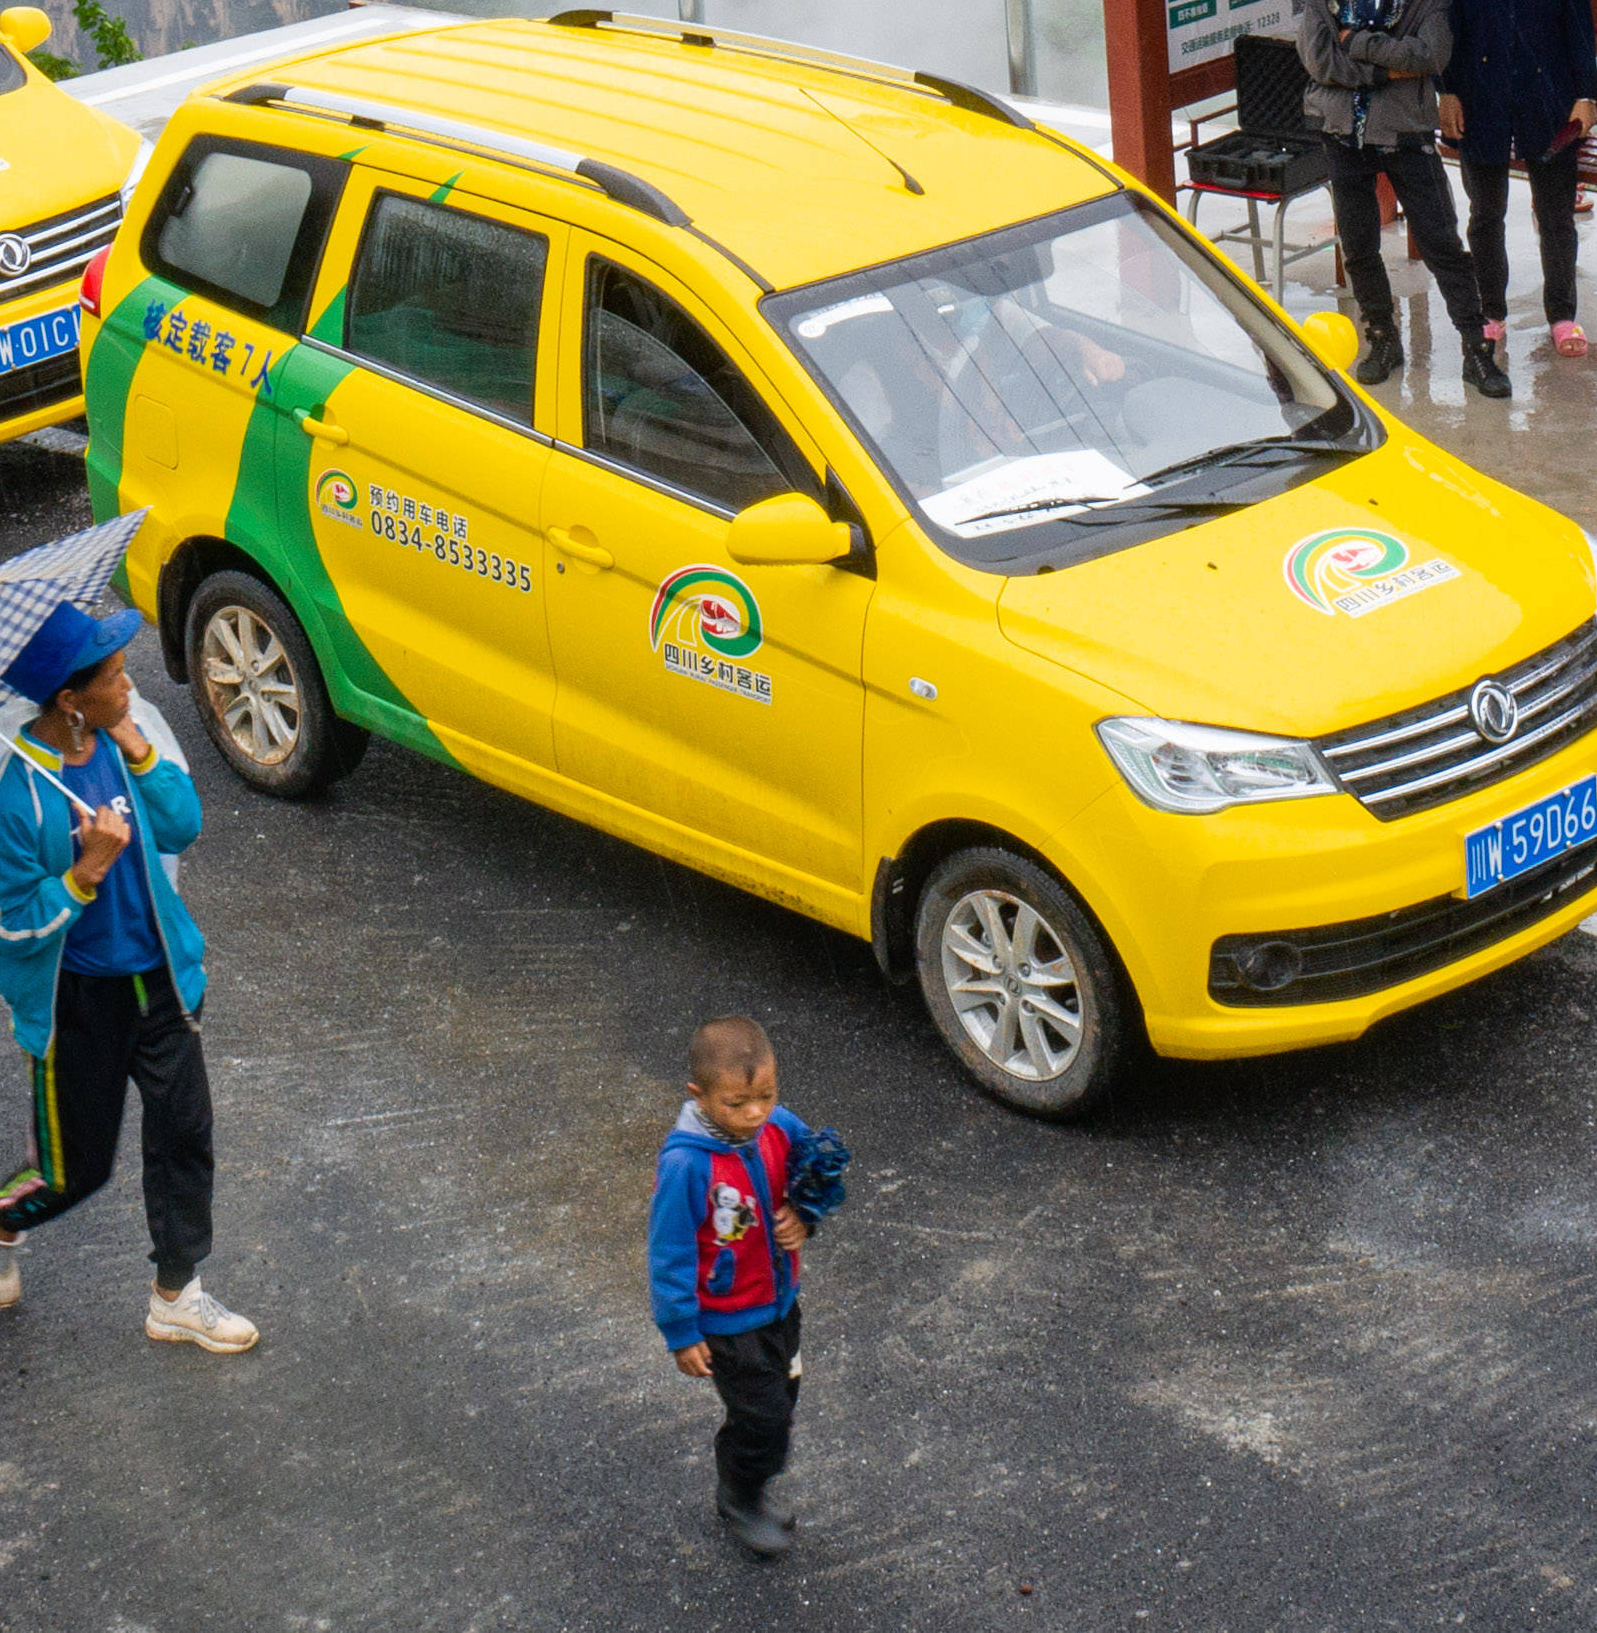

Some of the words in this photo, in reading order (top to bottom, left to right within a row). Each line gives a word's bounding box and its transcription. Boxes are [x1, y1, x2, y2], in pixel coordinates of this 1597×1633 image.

[369, 484, 468, 540] 预约用车电话
[371, 510, 532, 593] 0834-8533335
[664, 642, 771, 697] 四川乡村客运
